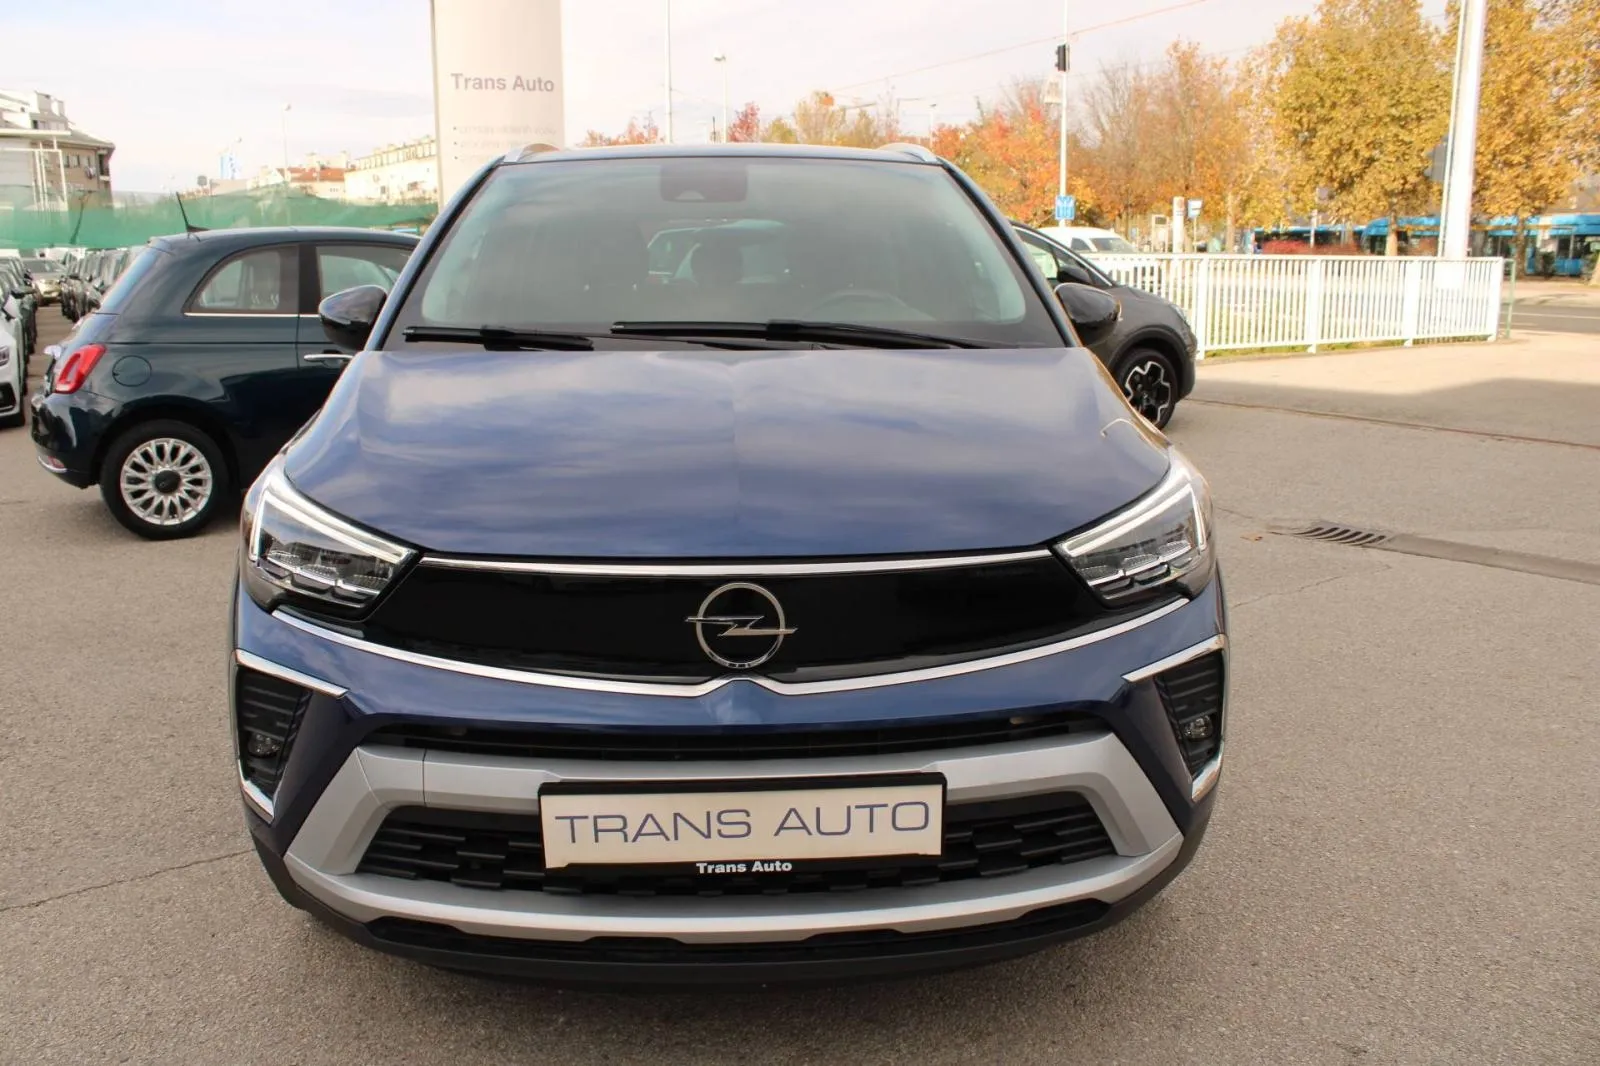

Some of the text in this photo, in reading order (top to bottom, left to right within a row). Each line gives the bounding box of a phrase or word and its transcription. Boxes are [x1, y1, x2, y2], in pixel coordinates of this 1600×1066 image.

[450, 73, 555, 92] Trans Auto
[555, 801, 930, 844] TRANS AUTO
[695, 860, 793, 874] Trans Auto
